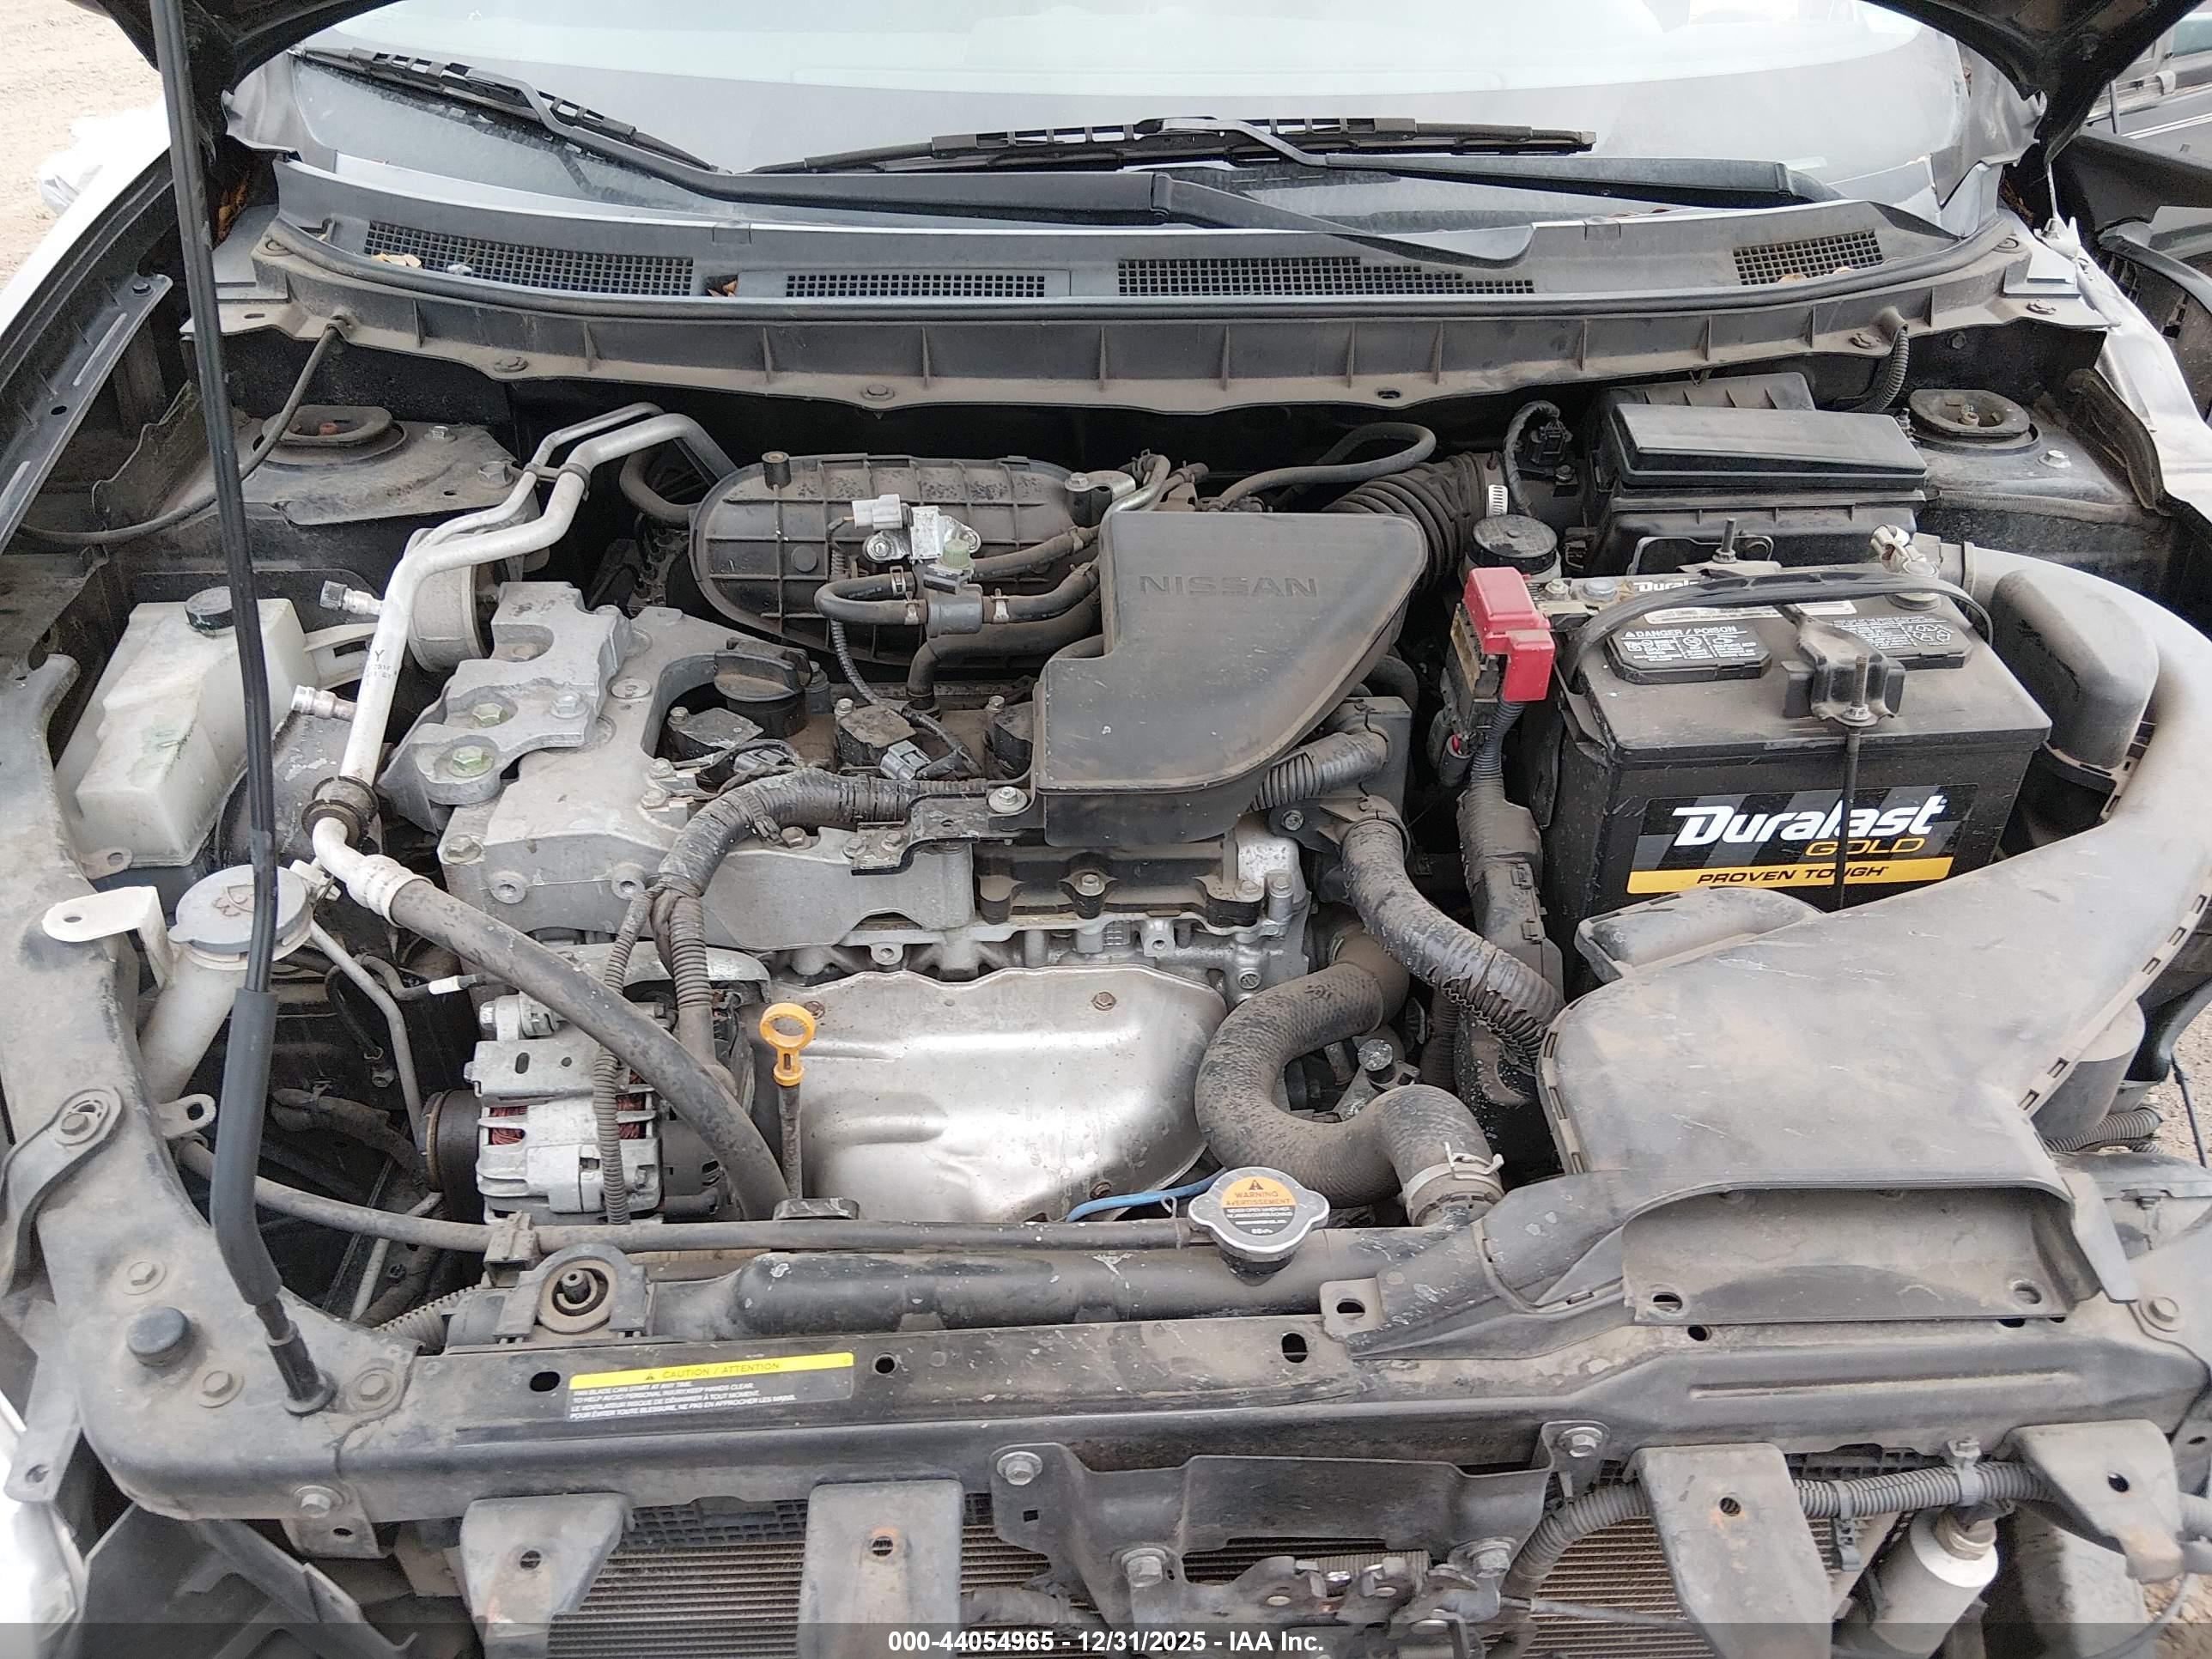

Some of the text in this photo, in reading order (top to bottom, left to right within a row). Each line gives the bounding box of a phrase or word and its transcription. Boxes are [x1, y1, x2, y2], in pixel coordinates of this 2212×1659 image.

[1139, 575, 1317, 598] NISSAN
[1633, 579, 1699, 592] Dural
[1635, 629, 1683, 638] DANGER
[1694, 625, 1737, 635] POISON
[1672, 795, 1946, 846] Duralast
[1805, 838, 1925, 858] GOLD
[1697, 869, 1796, 884] PROVEN
[663, 1369, 709, 1378] CAUTION
[723, 1363, 779, 1373] ATTENTION
